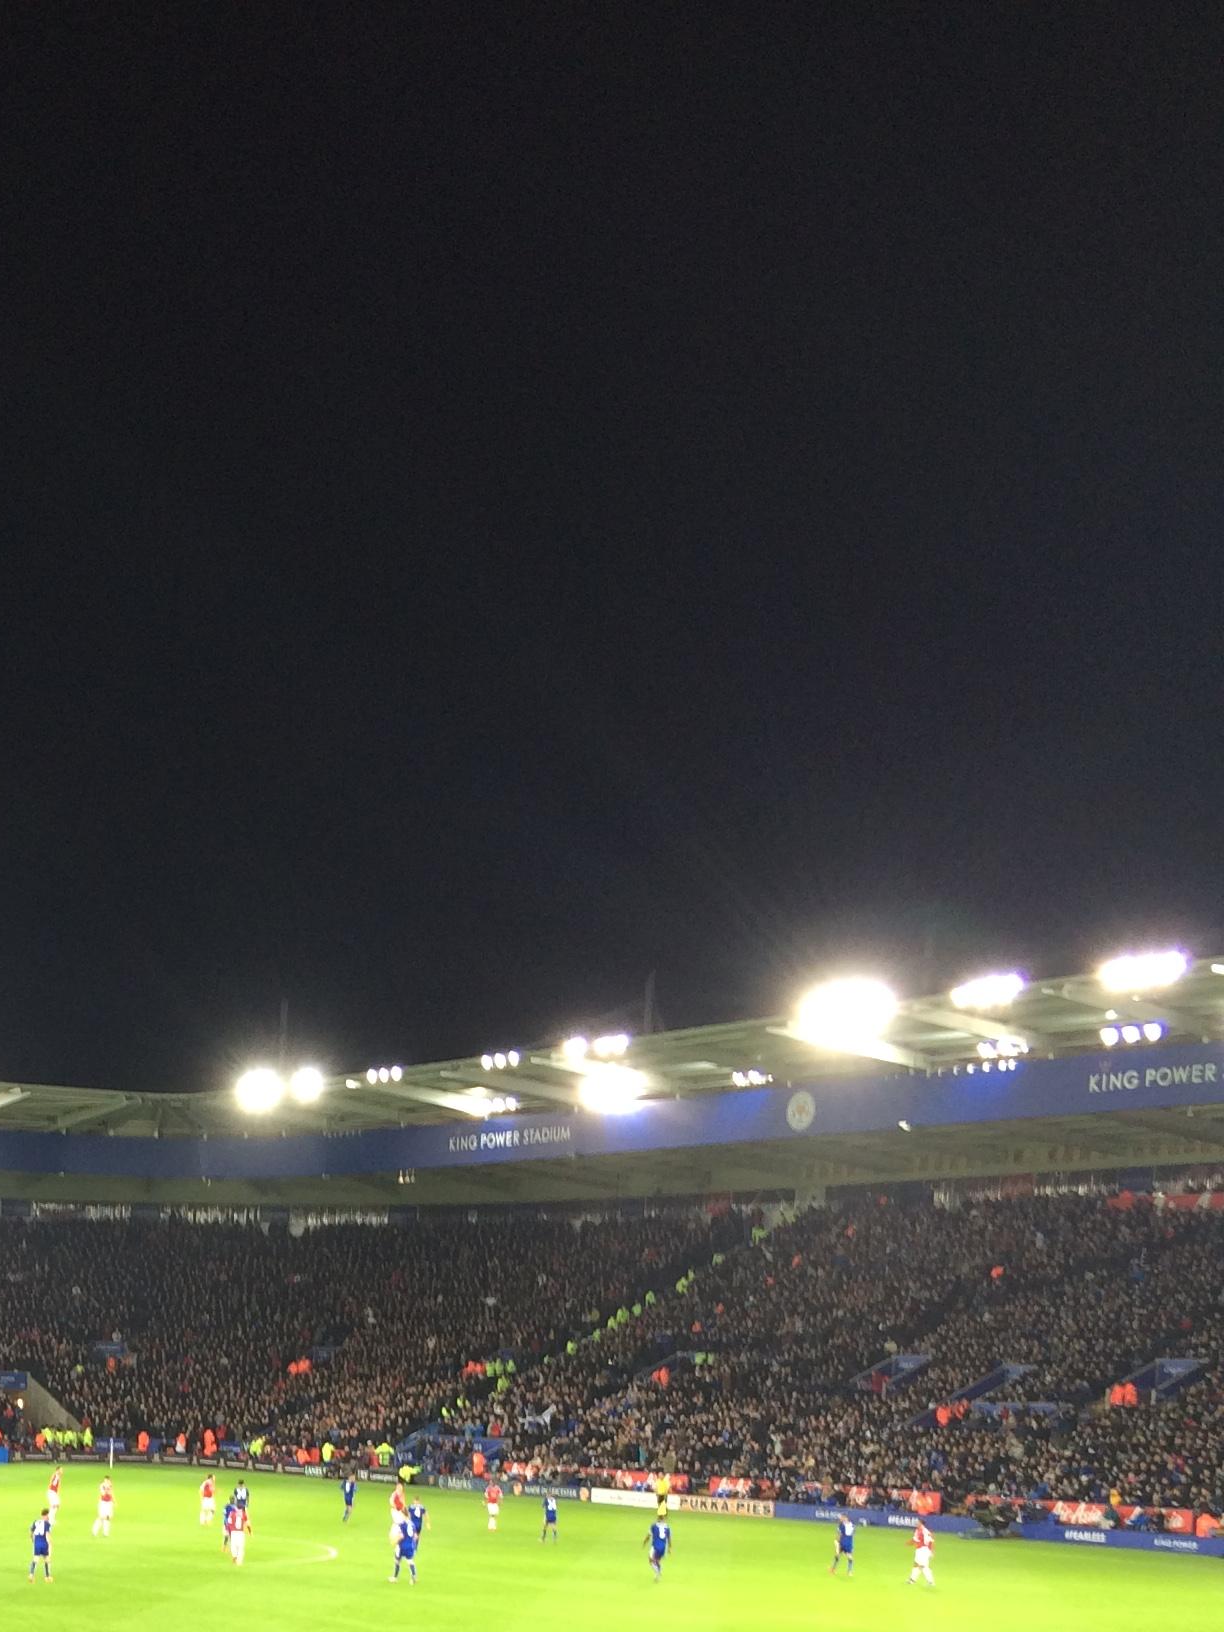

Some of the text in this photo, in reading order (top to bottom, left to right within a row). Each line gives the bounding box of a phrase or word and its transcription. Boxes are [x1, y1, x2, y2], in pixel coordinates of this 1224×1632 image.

[1088, 1069, 1139, 1093] KING
[1145, 1063, 1217, 1088] POWER
[448, 1126, 571, 1152] KING POWER STADIUM
[679, 1496, 772, 1514] PUKKA PIES
